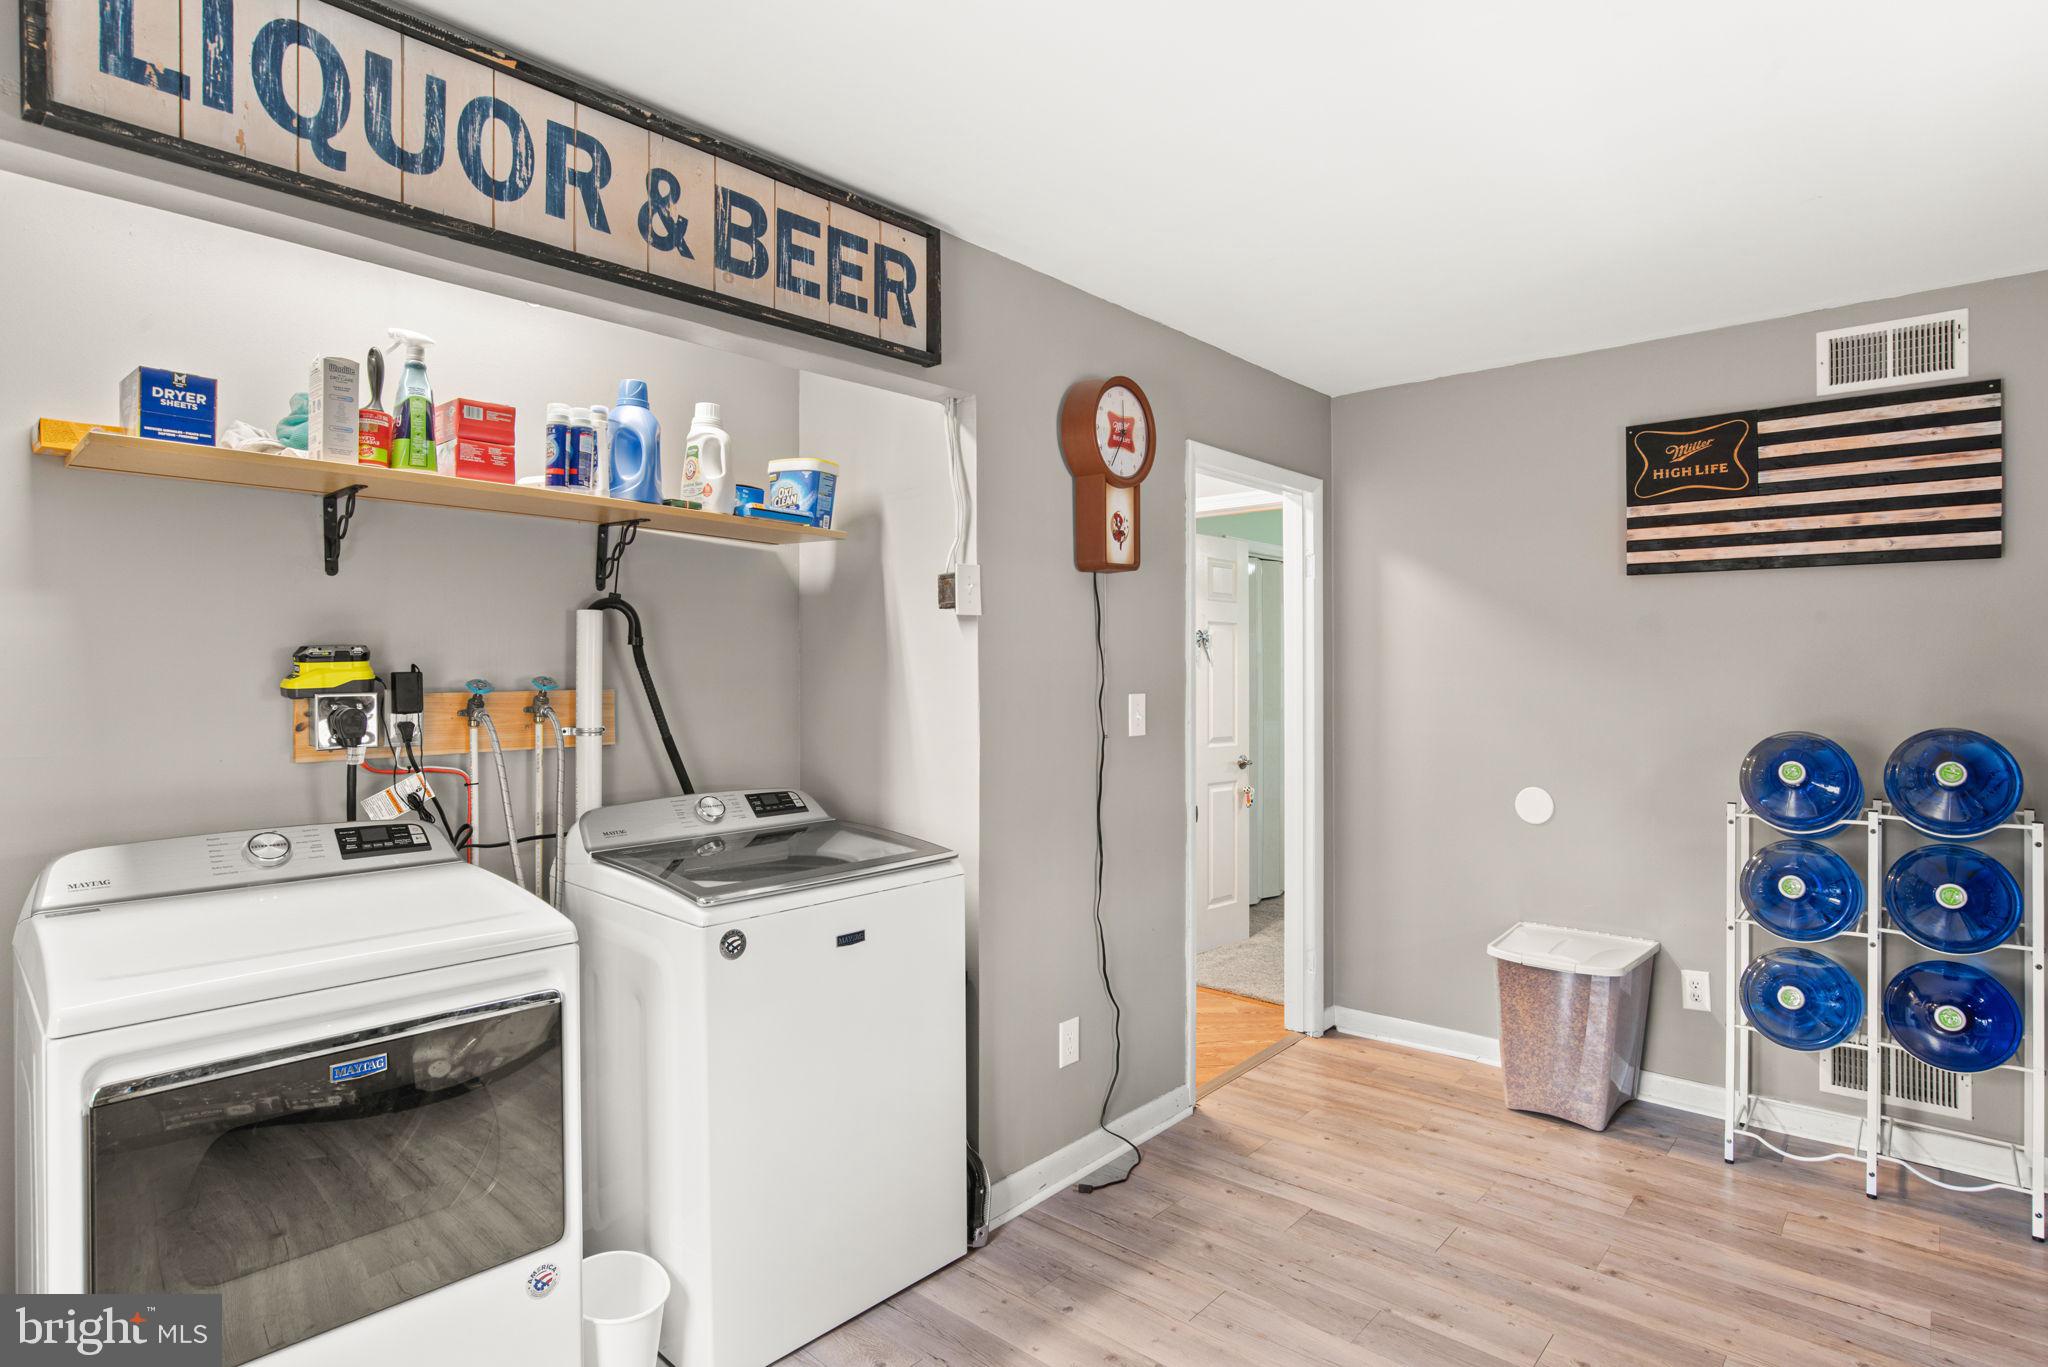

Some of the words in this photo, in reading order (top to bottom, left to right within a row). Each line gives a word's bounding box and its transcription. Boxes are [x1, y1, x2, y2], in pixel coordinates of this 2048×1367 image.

[98, 0, 612, 235] LIQUOR
[637, 167, 696, 261] &
[714, 183, 918, 329] BEER
[151, 386, 207, 405] DRYER
[160, 398, 198, 411] SHEETS
[1665, 438, 1716, 461] Miller
[1653, 467, 1693, 480] HIGH
[1695, 462, 1729, 476] LIFE
[778, 487, 793, 498] OXI
[773, 494, 798, 508] CLEAN
[602, 829, 628, 837] MAYTAG
[67, 880, 111, 889] MAYTAG
[838, 931, 865, 945] MAYTAG
[333, 1058, 385, 1080] MAYTAG
[527, 1264, 558, 1285] AMERICA
